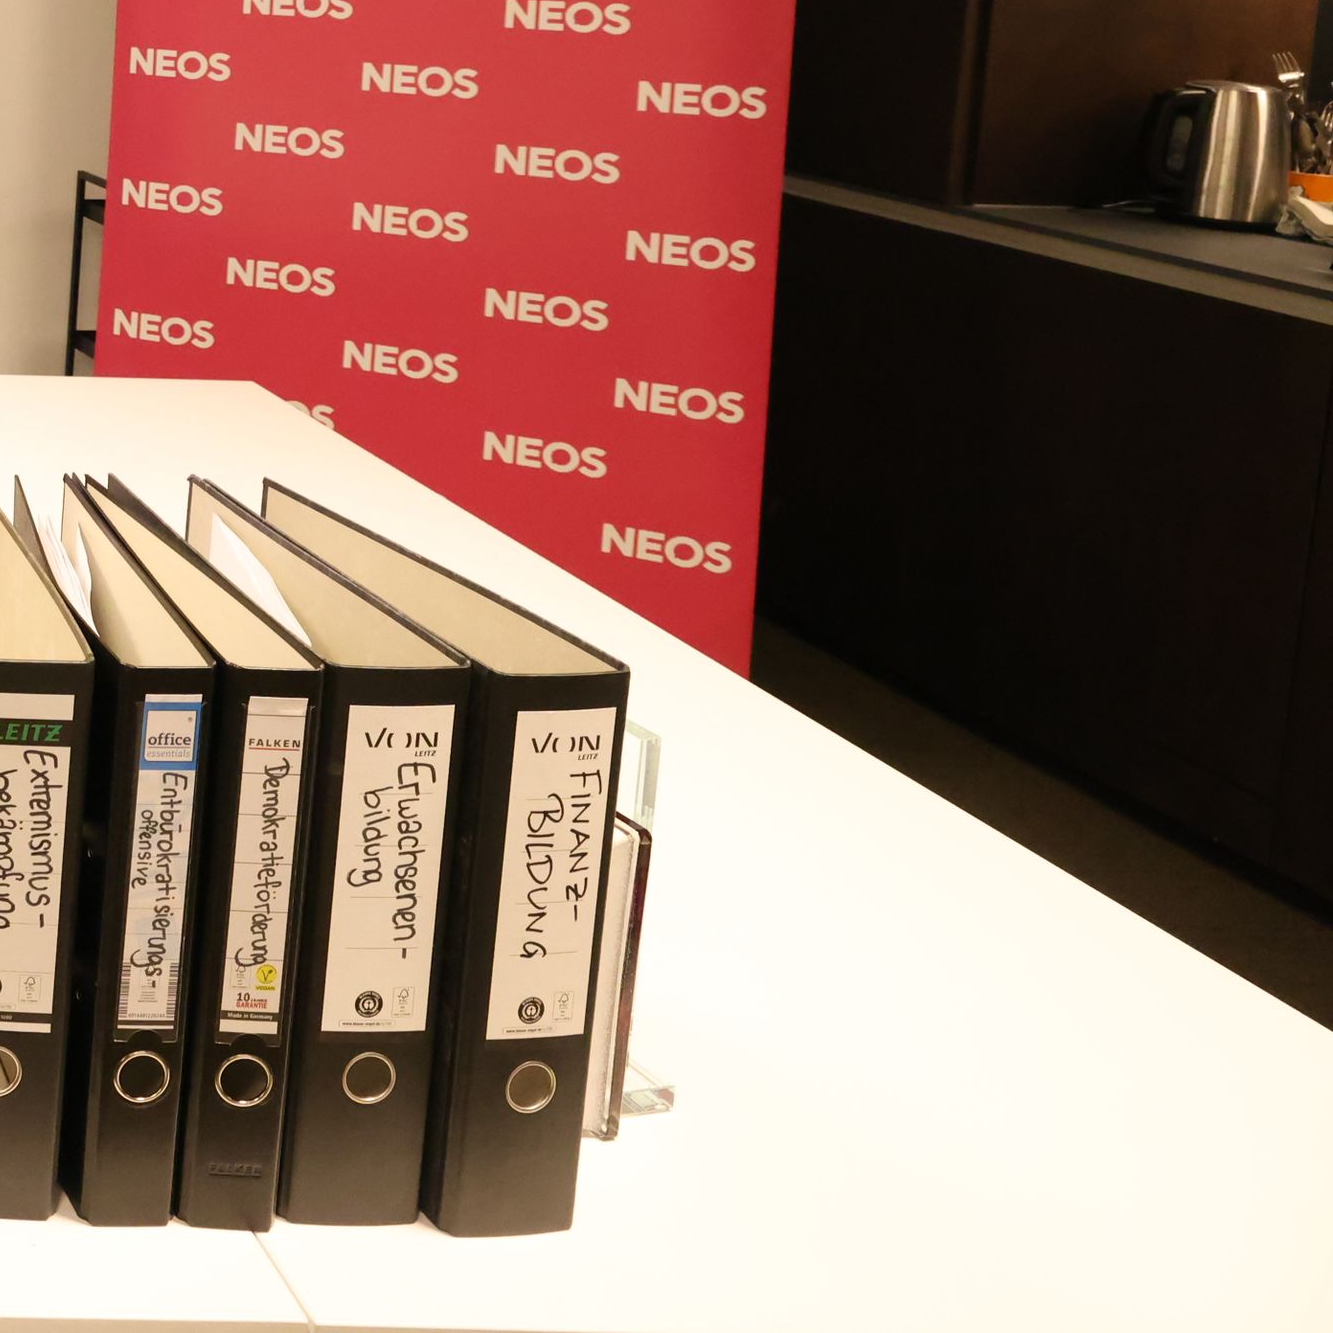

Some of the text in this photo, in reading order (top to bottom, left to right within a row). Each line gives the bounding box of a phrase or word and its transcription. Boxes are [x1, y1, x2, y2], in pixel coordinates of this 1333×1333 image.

[504, 0, 631, 35] NEOS
[129, 47, 231, 81] NEOS
[361, 62, 479, 99] NEOS
[636, 81, 767, 119] NEOS
[234, 123, 345, 159] NEOS
[494, 144, 621, 184] NEOS
[121, 179, 223, 216] NEOS
[352, 202, 469, 243] NEOS
[625, 230, 756, 272] NEOS
[226, 257, 336, 297] NEOS
[112, 308, 215, 349] NEOS
[484, 288, 609, 332] NEOS
[342, 340, 459, 384] NEOS
[614, 377, 745, 424] NEOS
[483, 431, 607, 478] NEOS
[601, 523, 732, 574] NEOS
[146, 748, 191, 759] essentials
[147, 733, 192, 747] office
[248, 737, 301, 748] FALKEN
[24, 748, 63, 928] Extremismus-
[131, 809, 159, 888] offensive
[347, 786, 394, 887] bildung
[565, 769, 602, 922] FINANZ-
[234, 757, 290, 966] Demokratieförderung
[393, 762, 436, 959] Erwachsenen-
[520, 793, 564, 959] BILDUNG
[236, 992, 250, 1002] 10
[236, 1001, 268, 1009] GARANTIE
[249, 1013, 273, 1021] Germany
